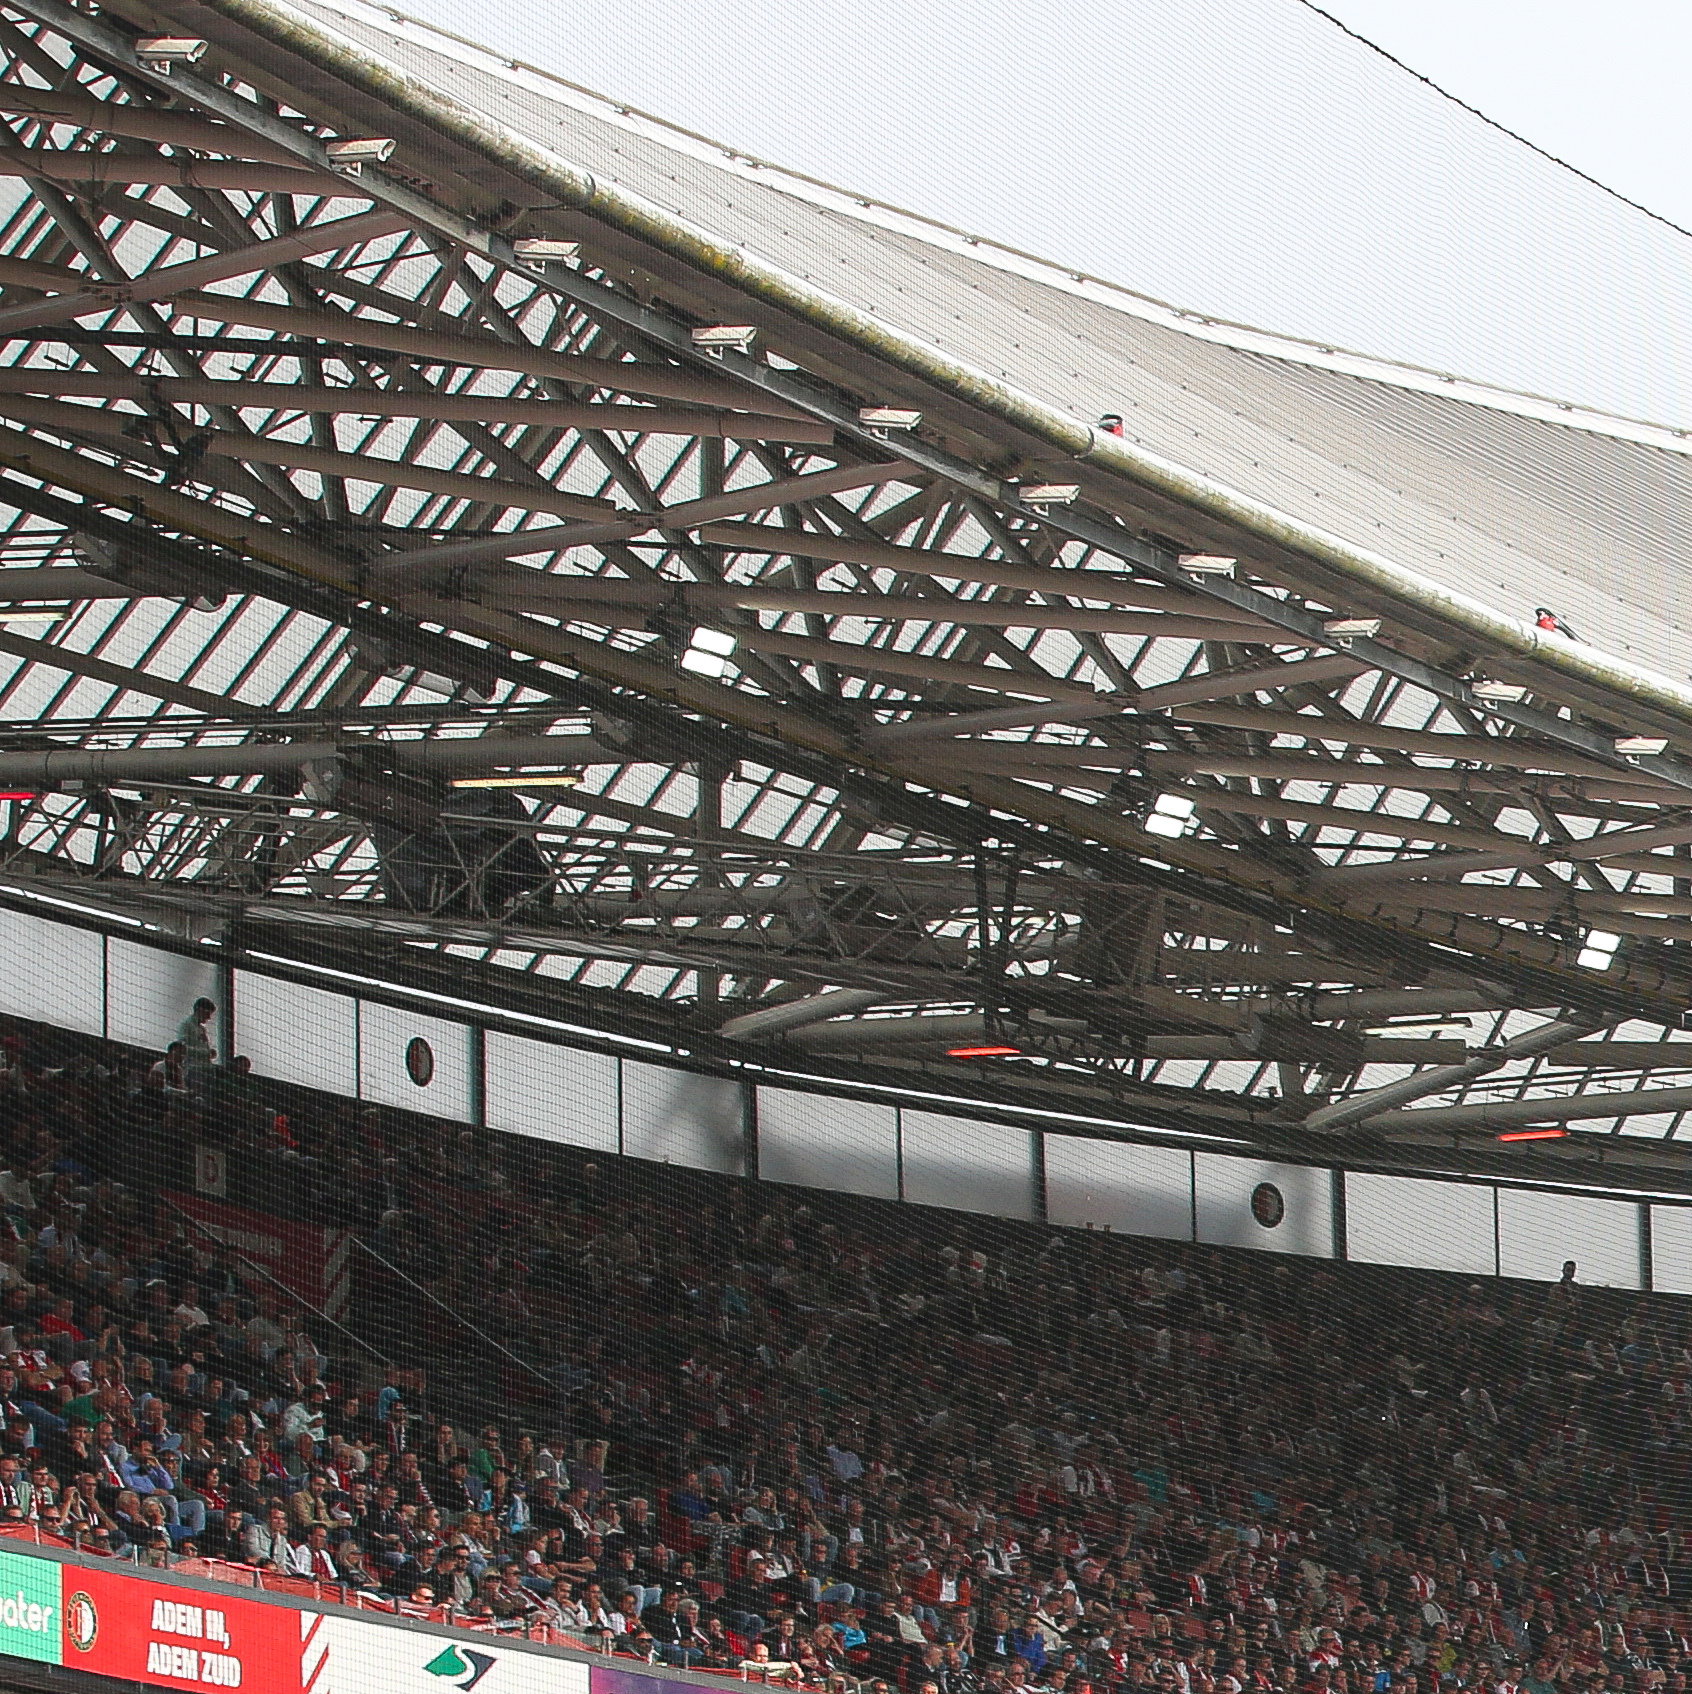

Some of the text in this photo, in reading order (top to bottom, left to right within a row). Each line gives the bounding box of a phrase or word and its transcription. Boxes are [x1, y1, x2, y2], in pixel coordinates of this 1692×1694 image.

[151, 1599, 231, 1650] ADEM IN,
[147, 1642, 242, 1688] ADEM ZUID
